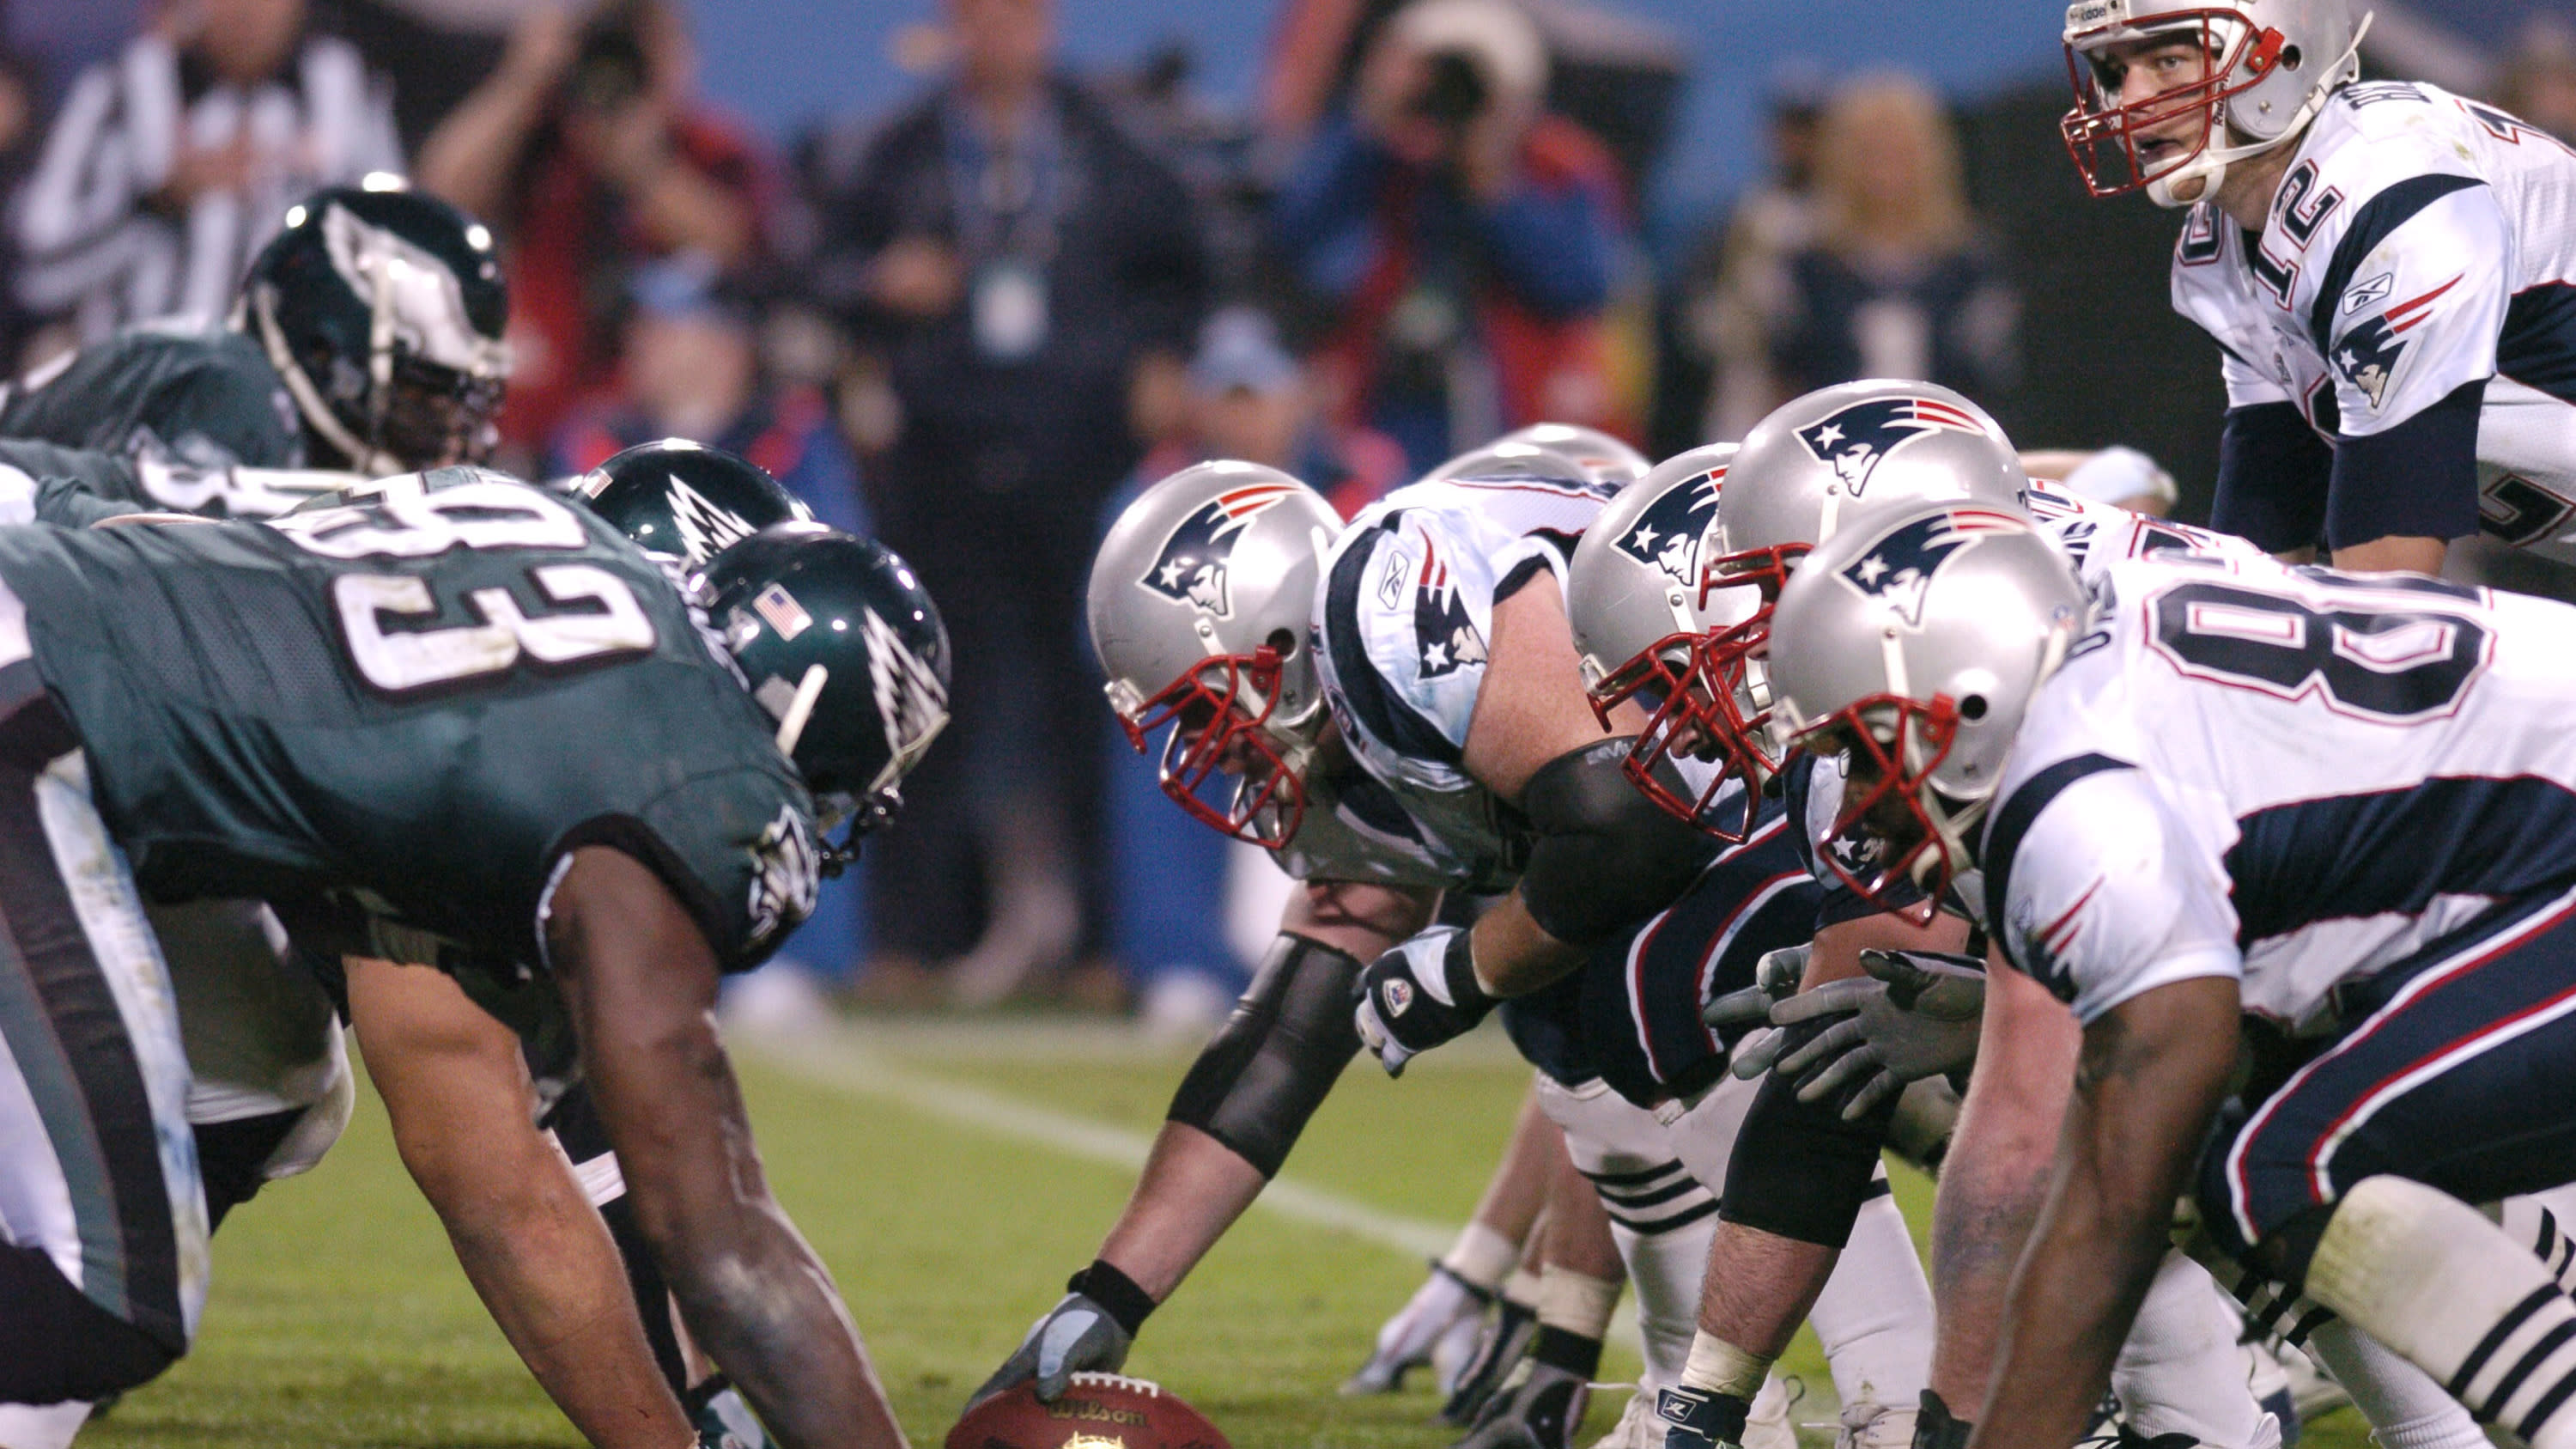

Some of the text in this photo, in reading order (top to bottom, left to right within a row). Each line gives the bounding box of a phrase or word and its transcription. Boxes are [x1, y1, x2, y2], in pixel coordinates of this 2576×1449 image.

[2254, 158, 2345, 312] 12
[264, 478, 659, 697] 93
[1049, 1398, 1145, 1427] Wilson
